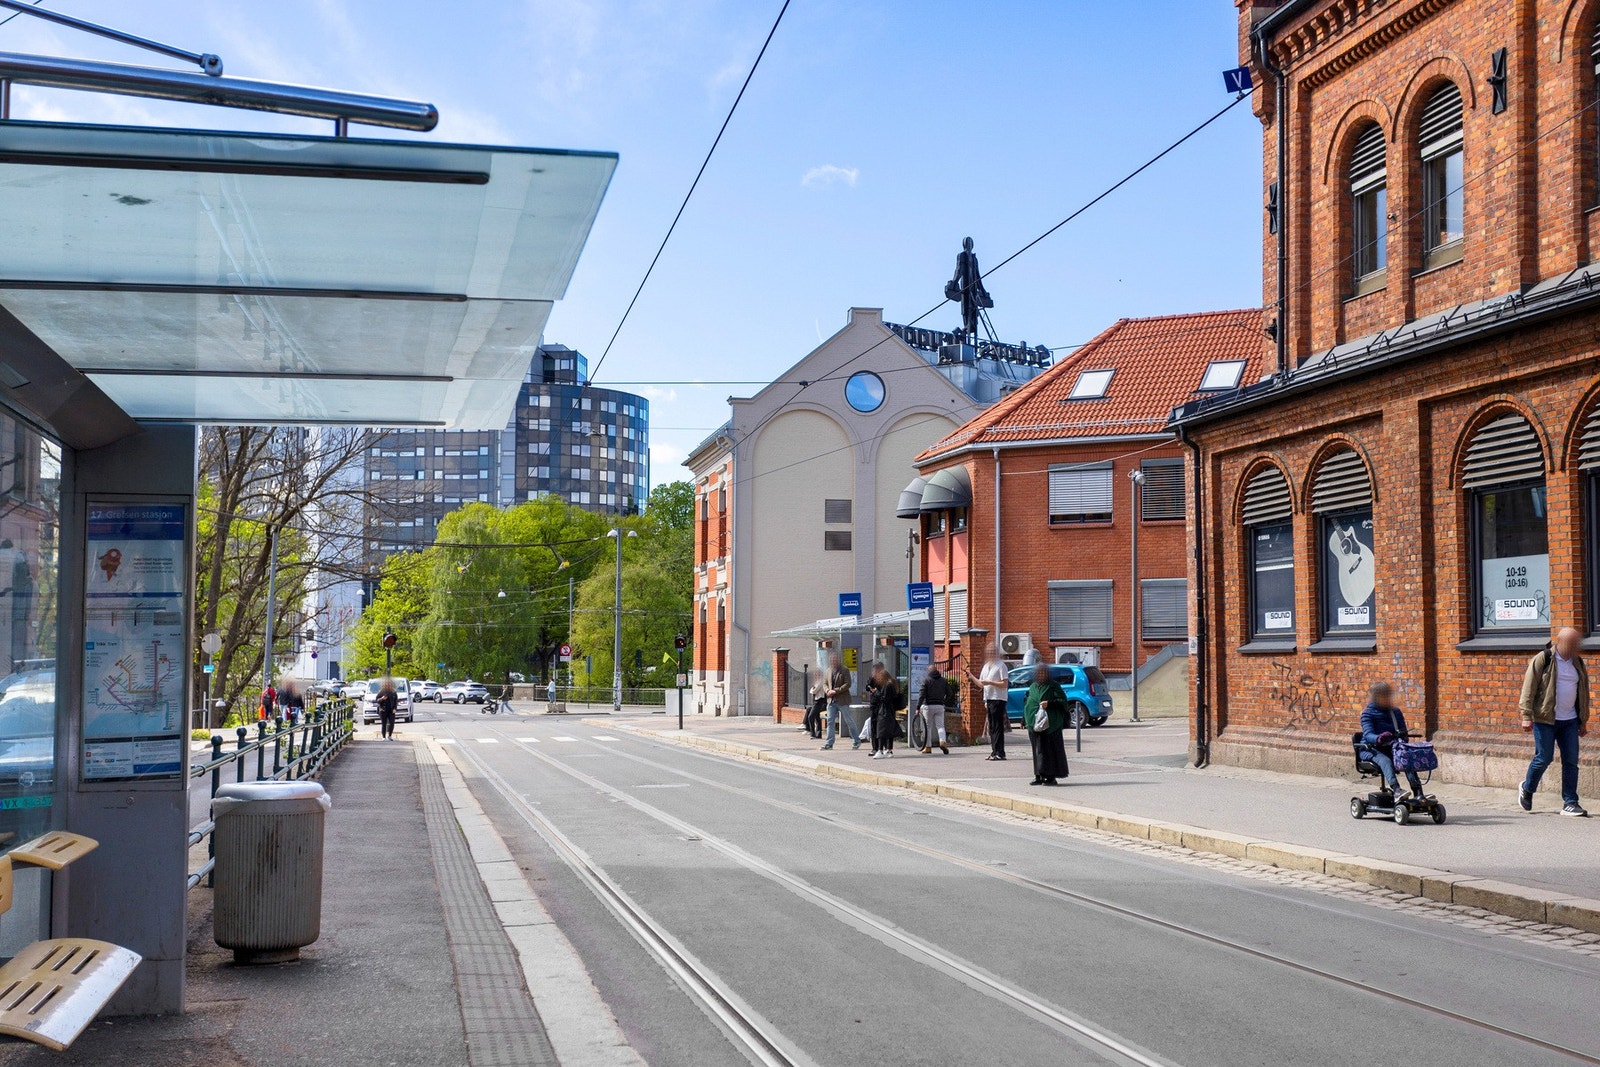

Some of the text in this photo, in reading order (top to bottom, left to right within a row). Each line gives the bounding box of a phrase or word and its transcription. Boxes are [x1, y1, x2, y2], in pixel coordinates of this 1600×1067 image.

[1231, 71, 1242, 88] V
[91, 510, 173, 520] 17 Grefsen stasjon
[1506, 566, 1527, 577] 10-19
[1505, 578, 1528, 589] (10-16)
